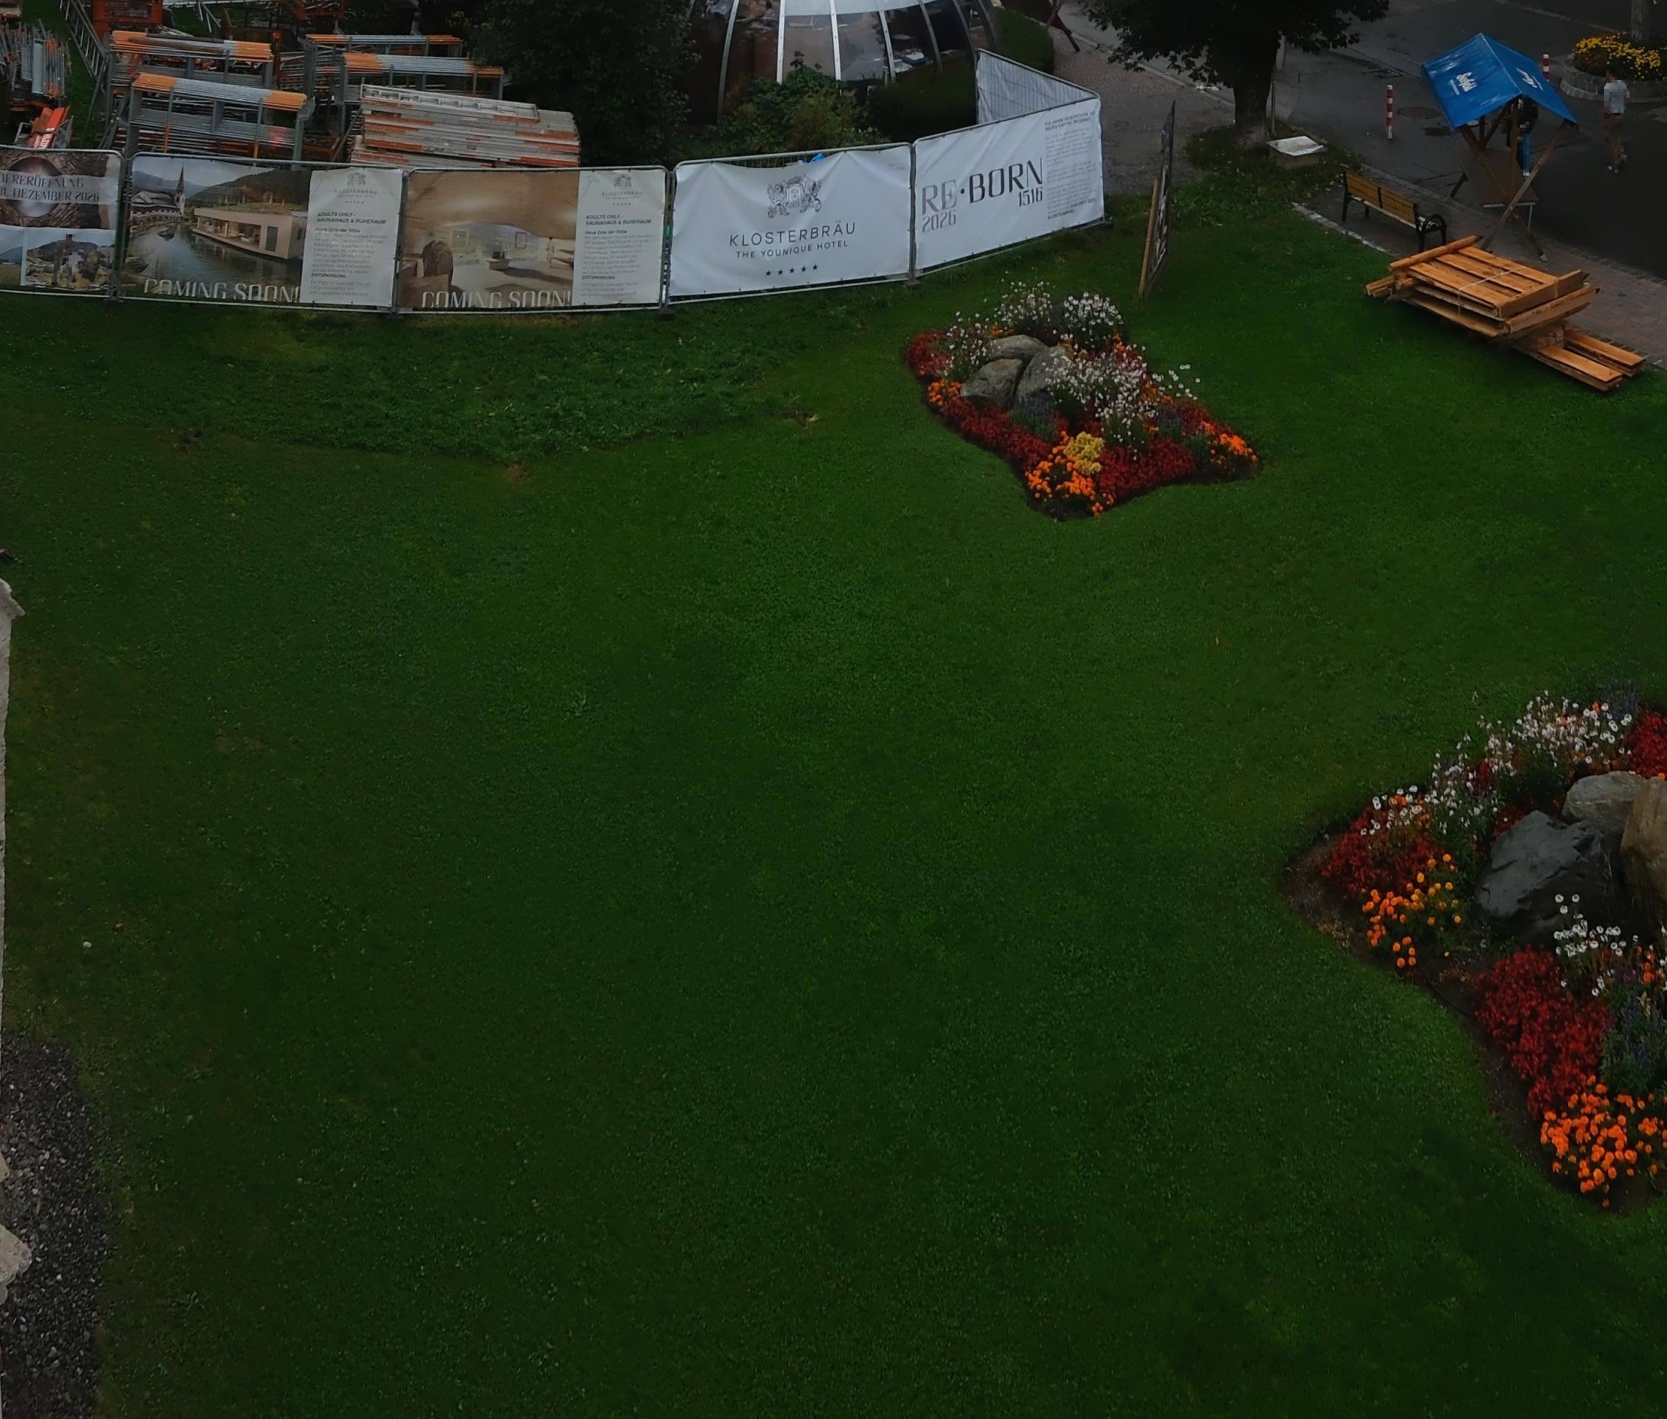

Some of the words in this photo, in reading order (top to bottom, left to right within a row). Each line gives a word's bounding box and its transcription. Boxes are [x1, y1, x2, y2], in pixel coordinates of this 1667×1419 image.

[14, 187, 71, 201] DEZEMBER
[1018, 187, 1043, 208] 1516
[922, 211, 957, 233] 2026
[729, 222, 857, 247] KLOSTERBRÄU
[736, 249, 754, 259] THE
[757, 244, 813, 257] YOUNIQUE
[817, 240, 848, 251] HOTEL
